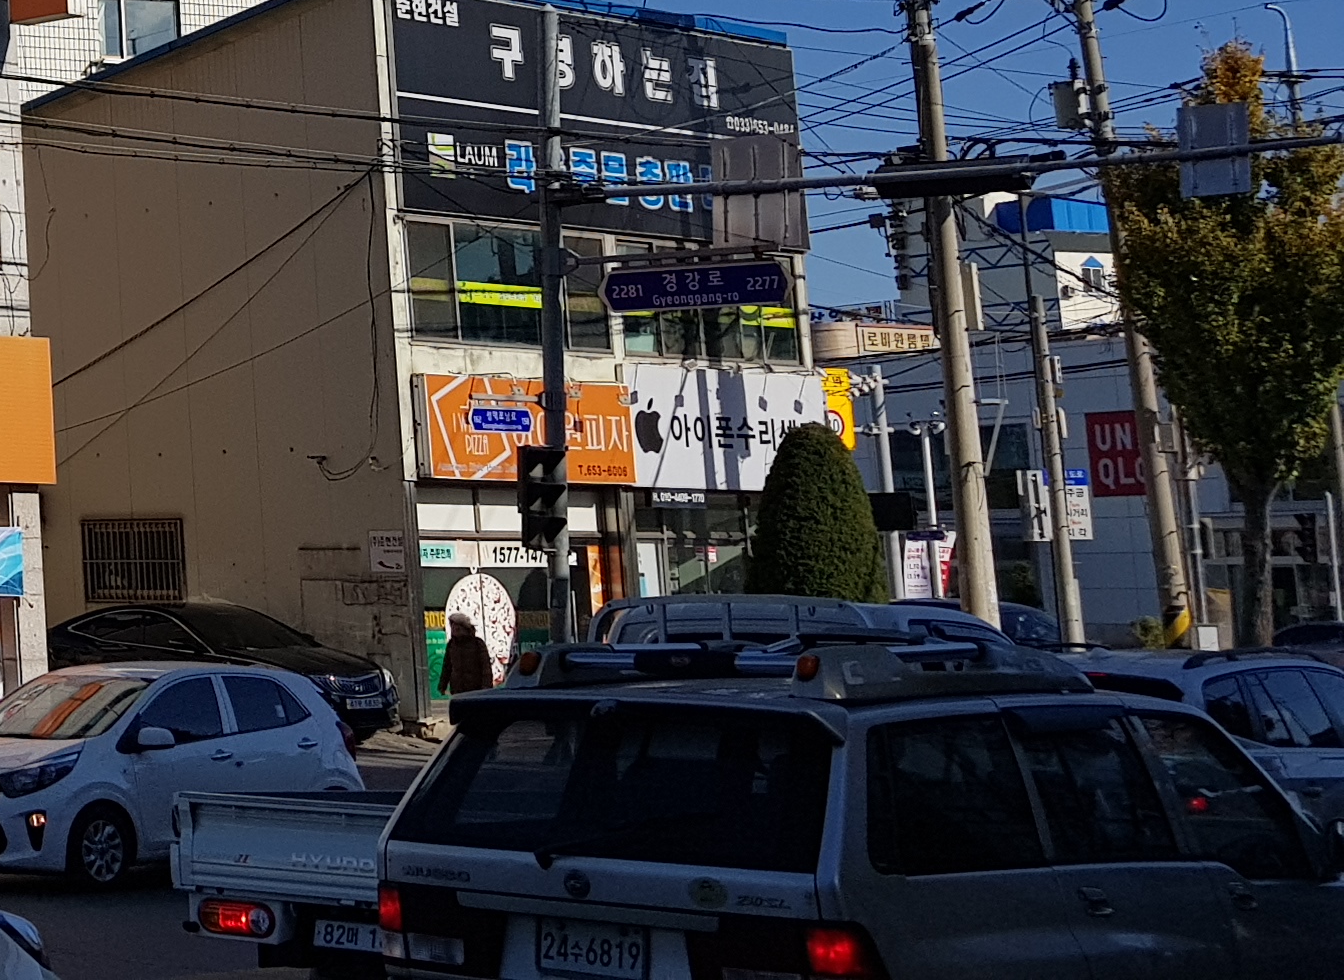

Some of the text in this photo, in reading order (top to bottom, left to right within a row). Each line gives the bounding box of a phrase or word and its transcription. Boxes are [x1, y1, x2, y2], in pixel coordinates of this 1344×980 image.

[611, 271, 779, 299] 2281 경강로 2277
[652, 291, 740, 307] Gyeonggang-ro
[465, 434, 489, 456] PIZZA
[291, 852, 375, 868] HYUND
[543, 931, 641, 971] 24수6819
